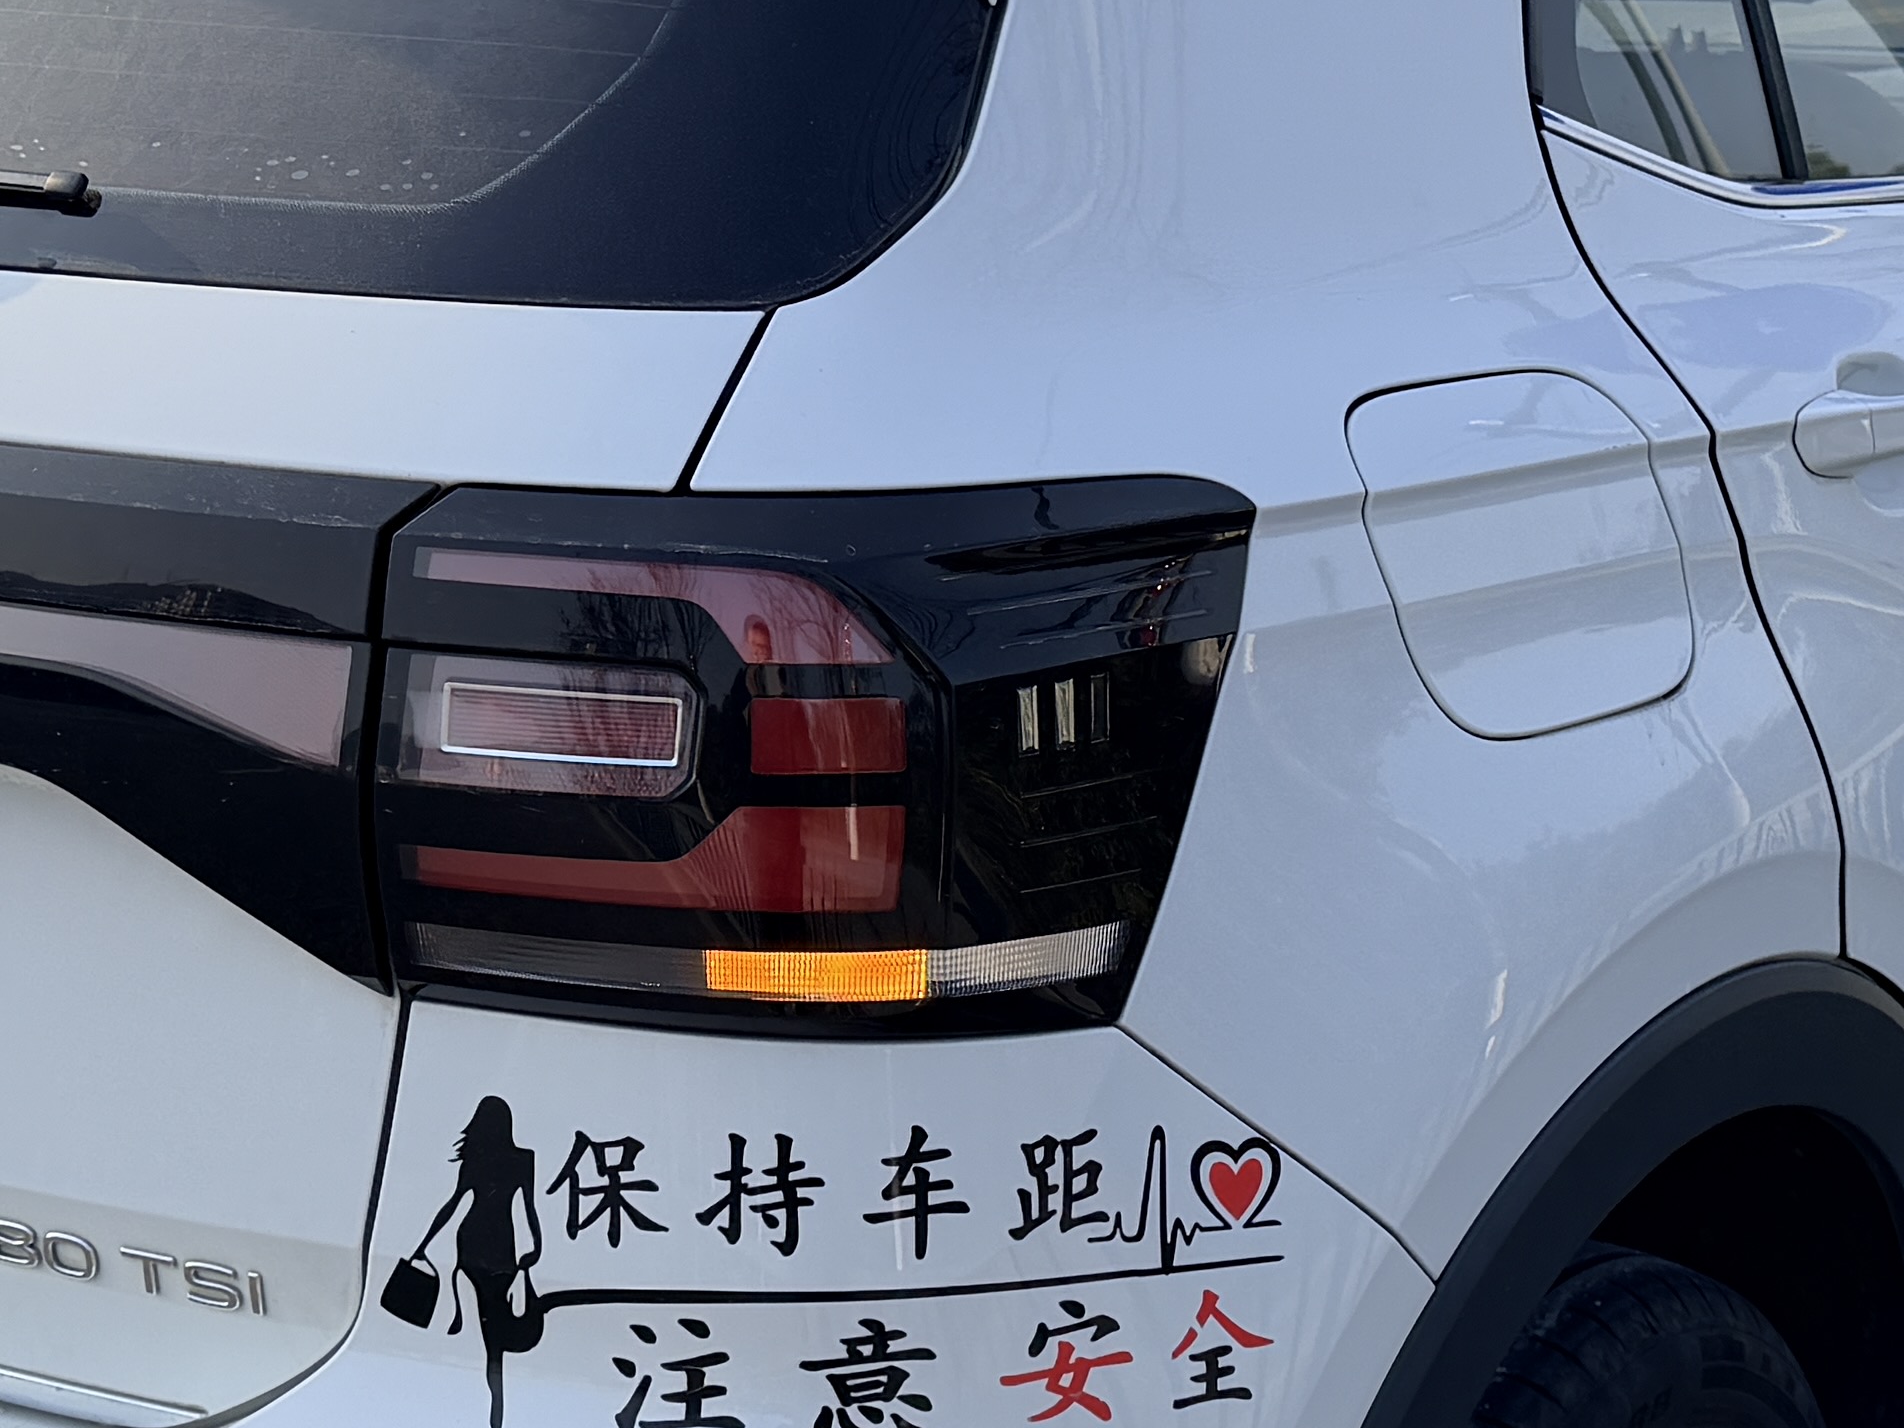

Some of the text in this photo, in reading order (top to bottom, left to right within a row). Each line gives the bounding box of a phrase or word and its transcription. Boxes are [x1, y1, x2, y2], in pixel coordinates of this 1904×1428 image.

[547, 1125, 1110, 1259] 保持车距
[119, 1246, 266, 1316] TSI
